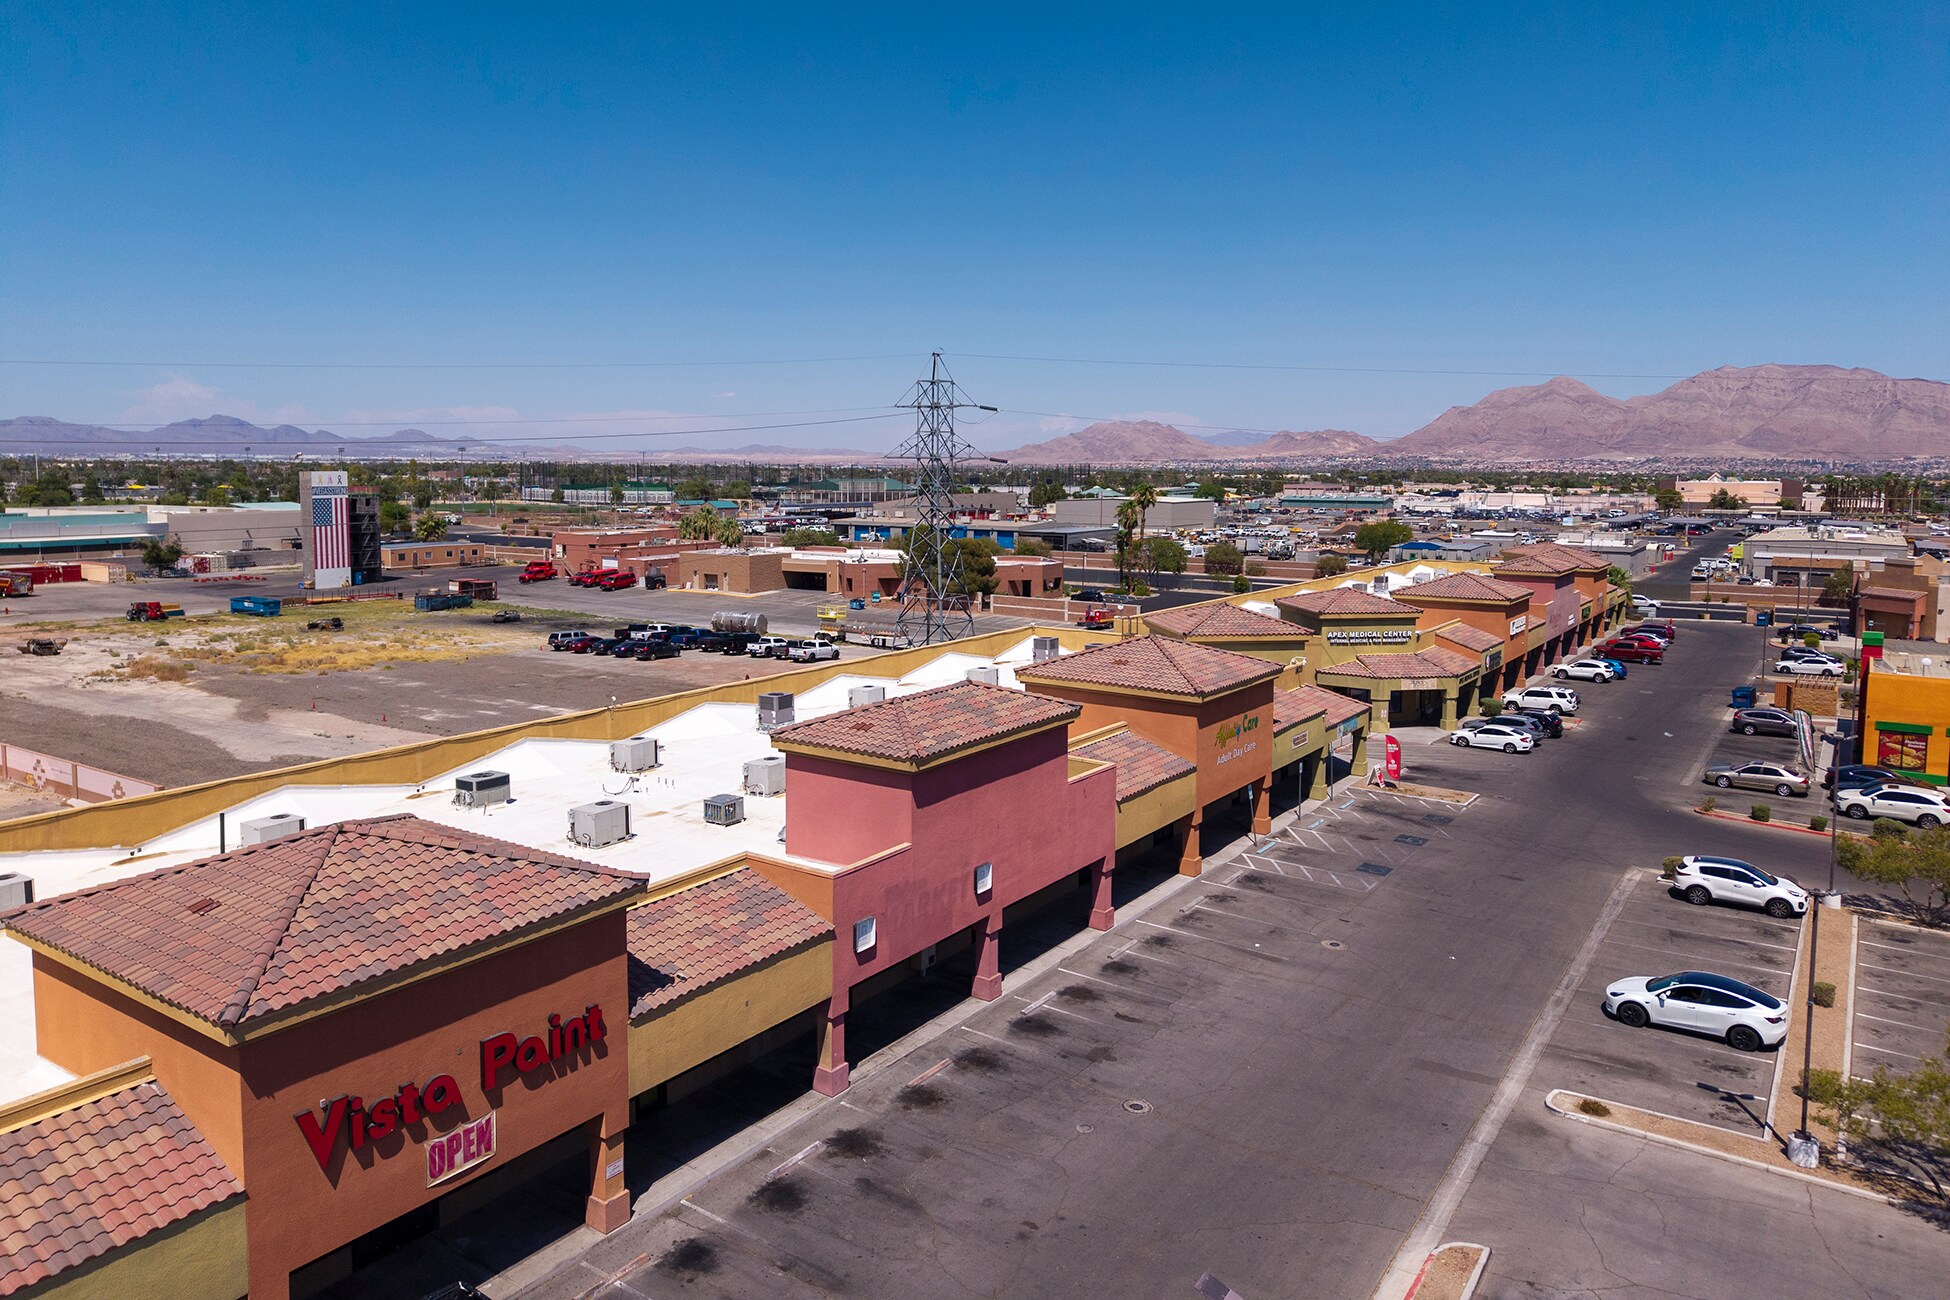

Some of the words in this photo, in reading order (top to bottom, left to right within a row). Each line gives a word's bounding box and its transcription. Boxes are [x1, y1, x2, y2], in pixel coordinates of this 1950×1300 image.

[1243, 713, 1258, 733] Care
[1217, 751, 1232, 765] Adult
[1233, 748, 1243, 758] Day
[1244, 741, 1256, 753] Care
[293, 1073, 463, 1169] Vista
[479, 1003, 604, 1091] Paint
[428, 1117, 493, 1179] OPEN
